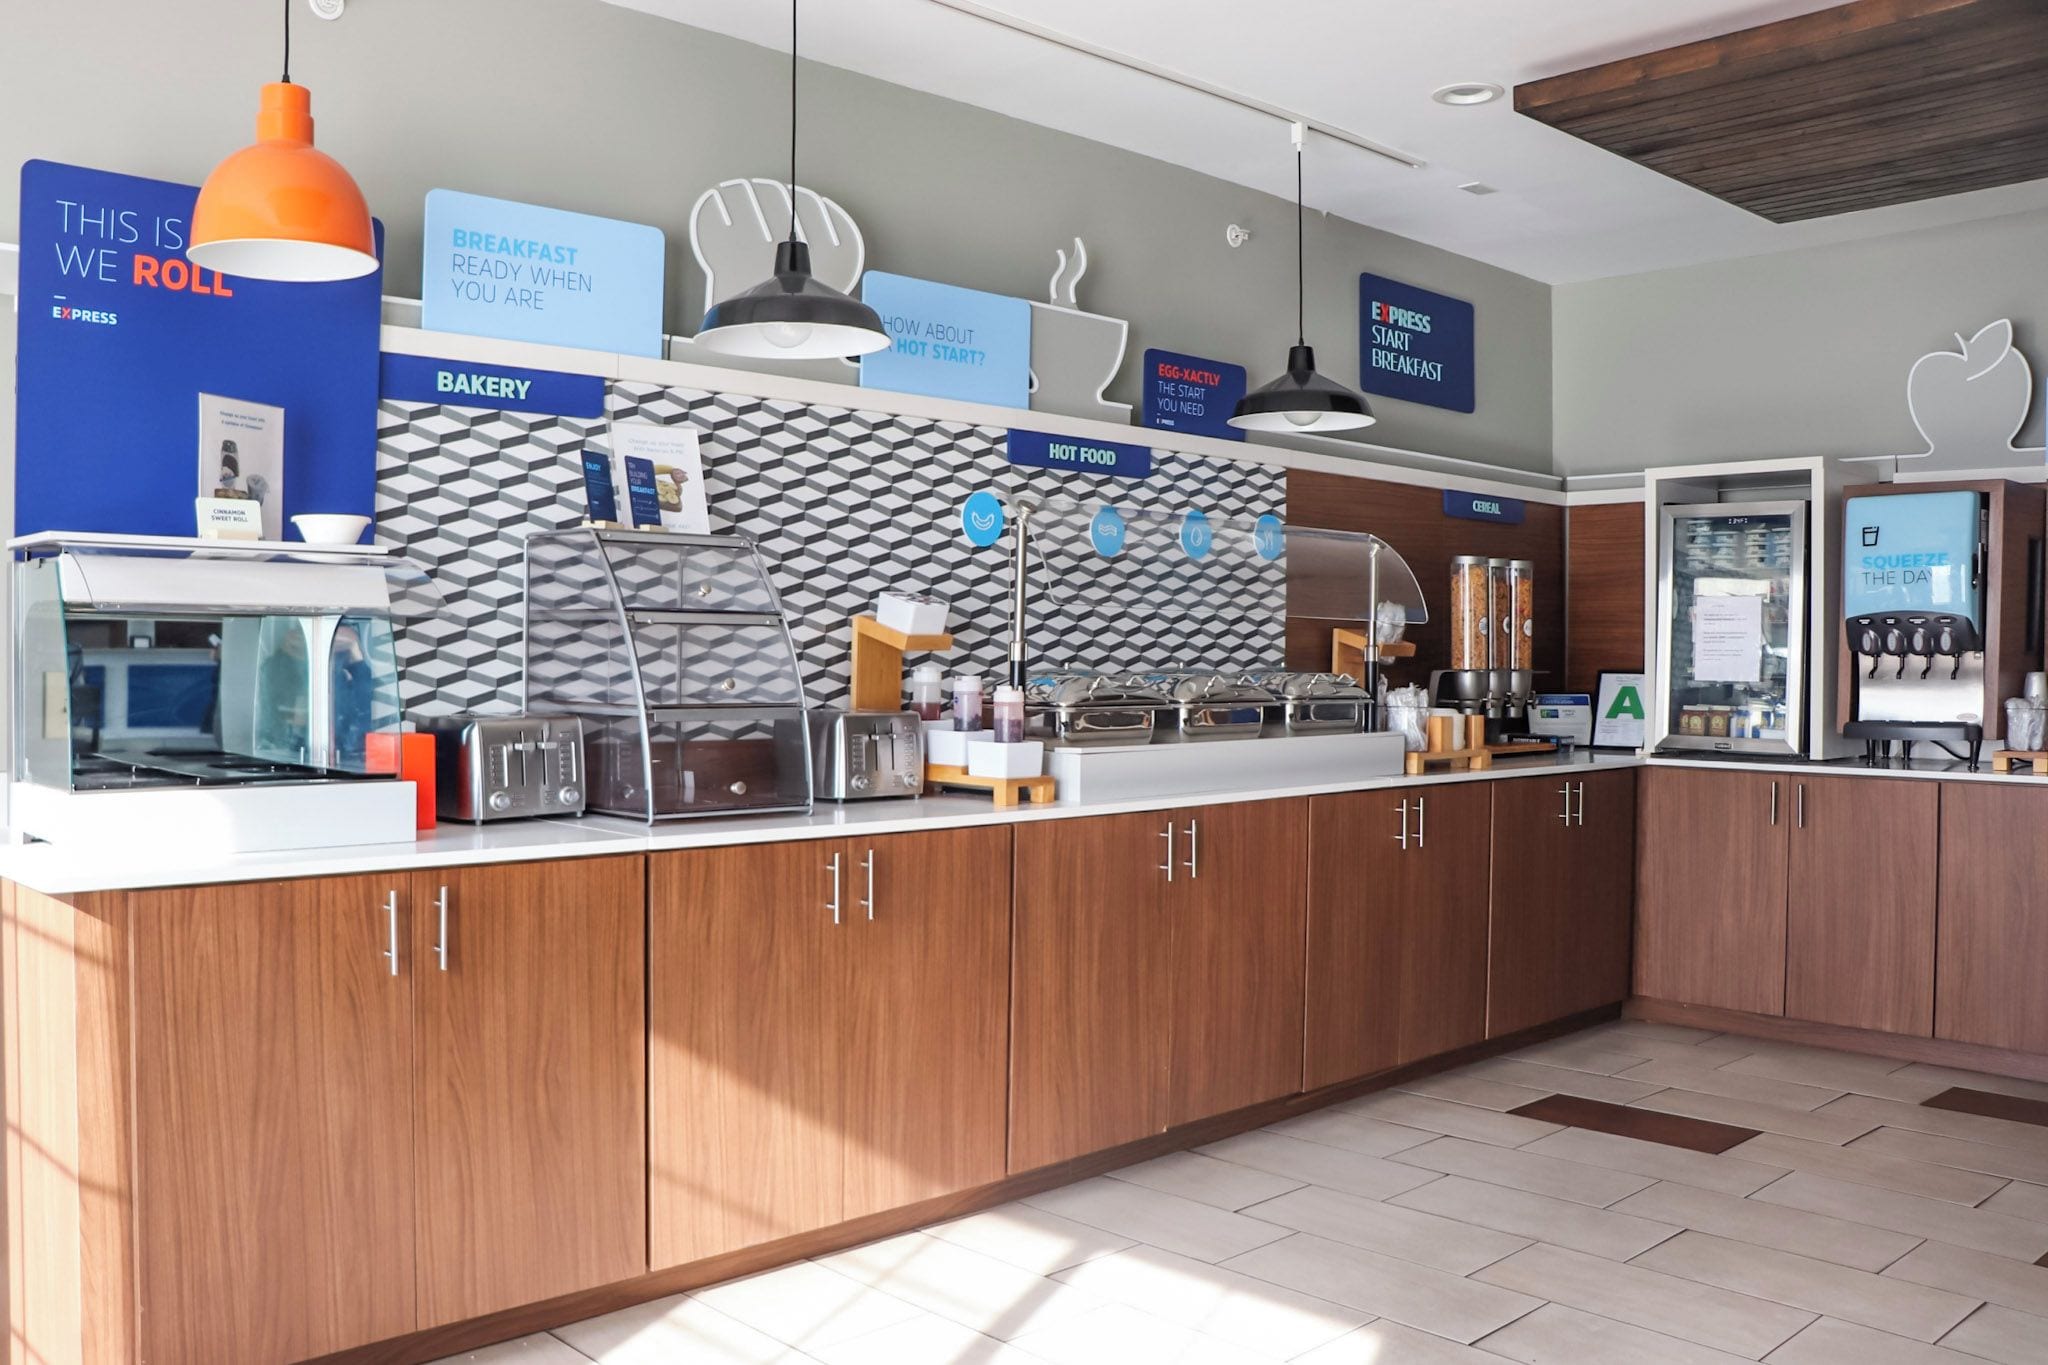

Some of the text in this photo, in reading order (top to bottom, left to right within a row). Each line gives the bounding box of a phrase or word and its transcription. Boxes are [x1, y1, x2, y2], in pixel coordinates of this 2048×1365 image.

[56, 199, 183, 250] THIS IS
[453, 228, 578, 266] BREAKFAST
[55, 242, 233, 297] WE ROLL
[452, 254, 592, 292] READY WHEN
[451, 278, 544, 310] YOU ARE
[52, 305, 118, 325] EXPRESS
[883, 314, 975, 344] HOW ABOUT
[1372, 301, 1431, 333] EXPRESS
[1372, 324, 1410, 351] START
[897, 338, 927, 356] HOT
[933, 343, 986, 366] START?
[1372, 348, 1443, 382] BREAKFAST
[437, 370, 532, 400] BAKERY
[1158, 363, 1221, 386] EGG-XACTLY
[1158, 381, 1206, 401] THE START
[1157, 398, 1205, 416] YOU NEED
[1049, 443, 1117, 466] HOT FOOD
[213, 508, 246, 516] CINNAMON
[1472, 500, 1501, 514] CEREAL
[1861, 552, 1949, 569] SQUEEZE
[1861, 570, 1896, 585] THE
[1605, 686, 1645, 720] A
